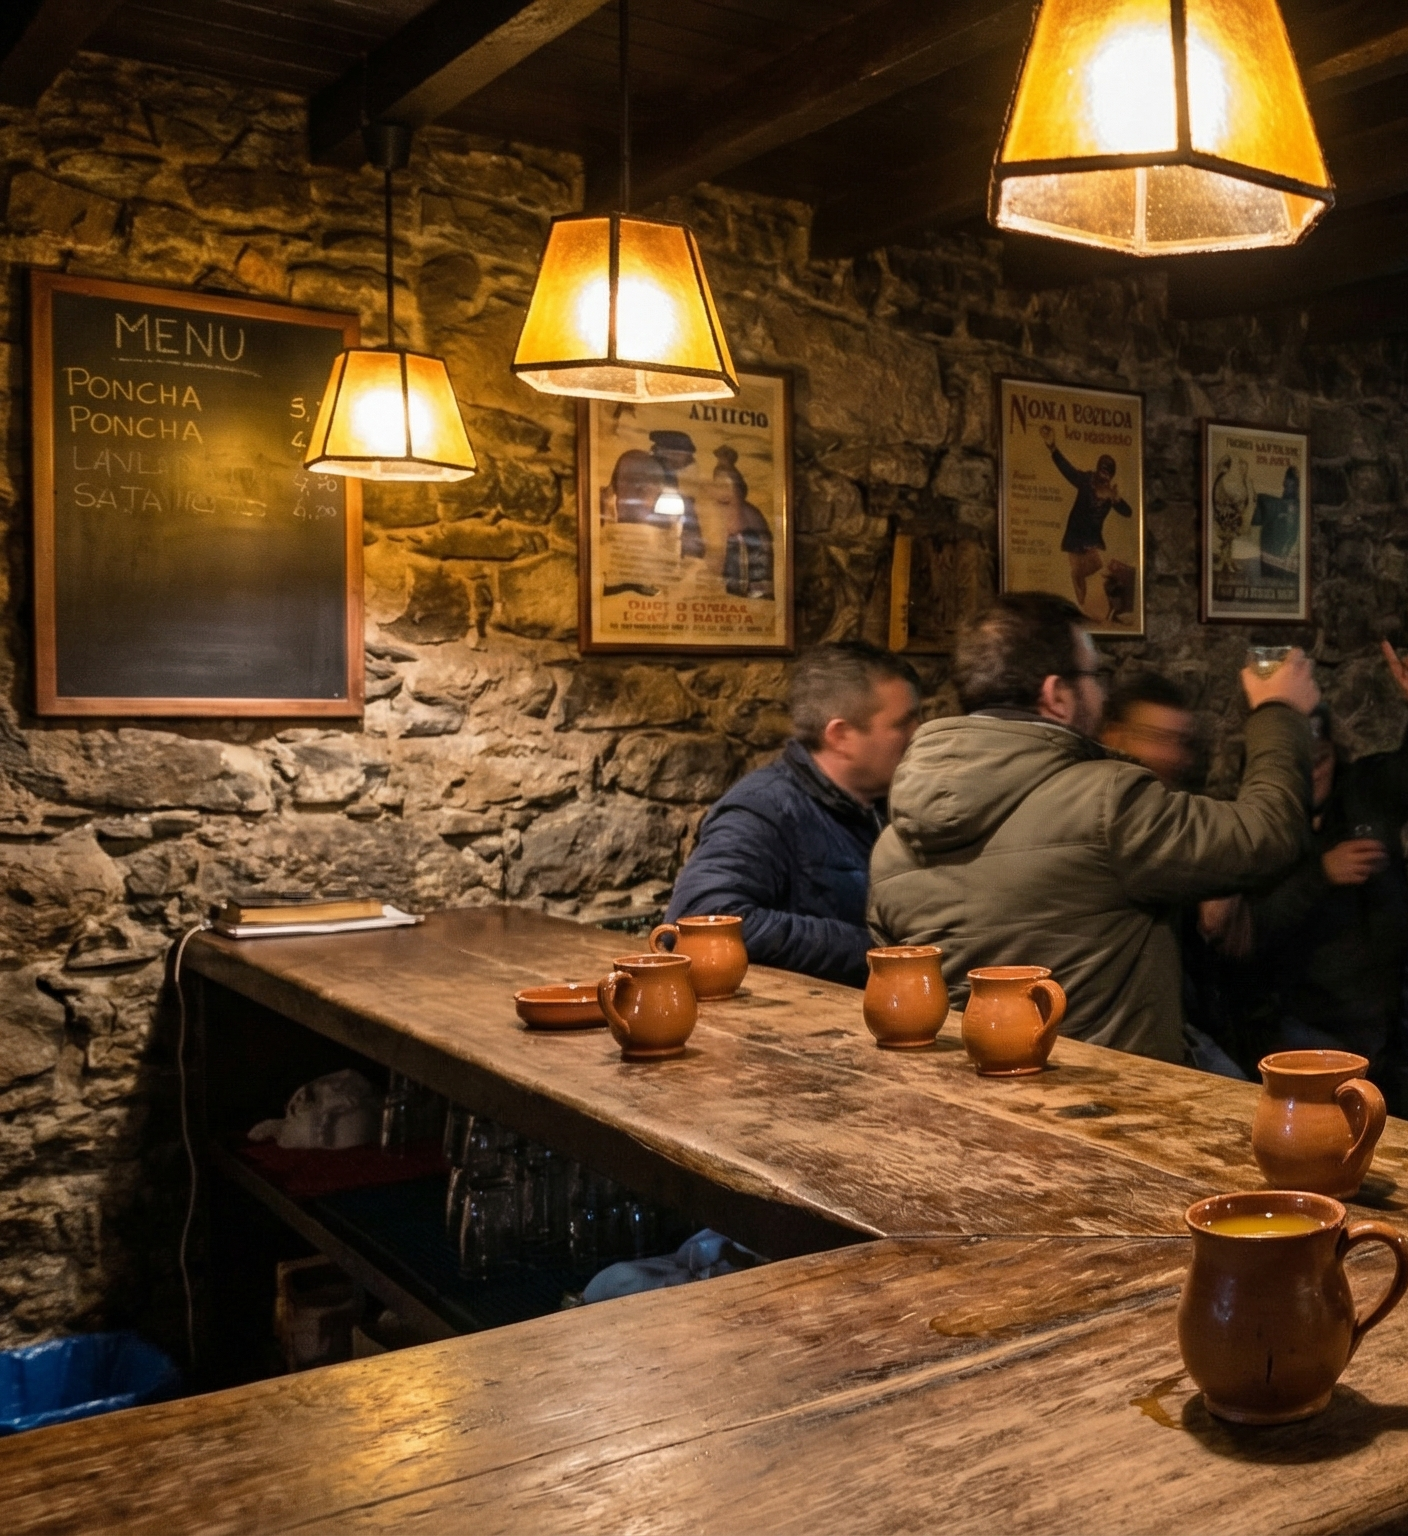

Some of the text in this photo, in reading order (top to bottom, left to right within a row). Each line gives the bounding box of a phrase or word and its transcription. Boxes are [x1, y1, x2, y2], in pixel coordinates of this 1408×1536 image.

[115, 313, 245, 362] MENU
[63, 366, 203, 412] PONCHA
[69, 405, 203, 443] PONCHA
